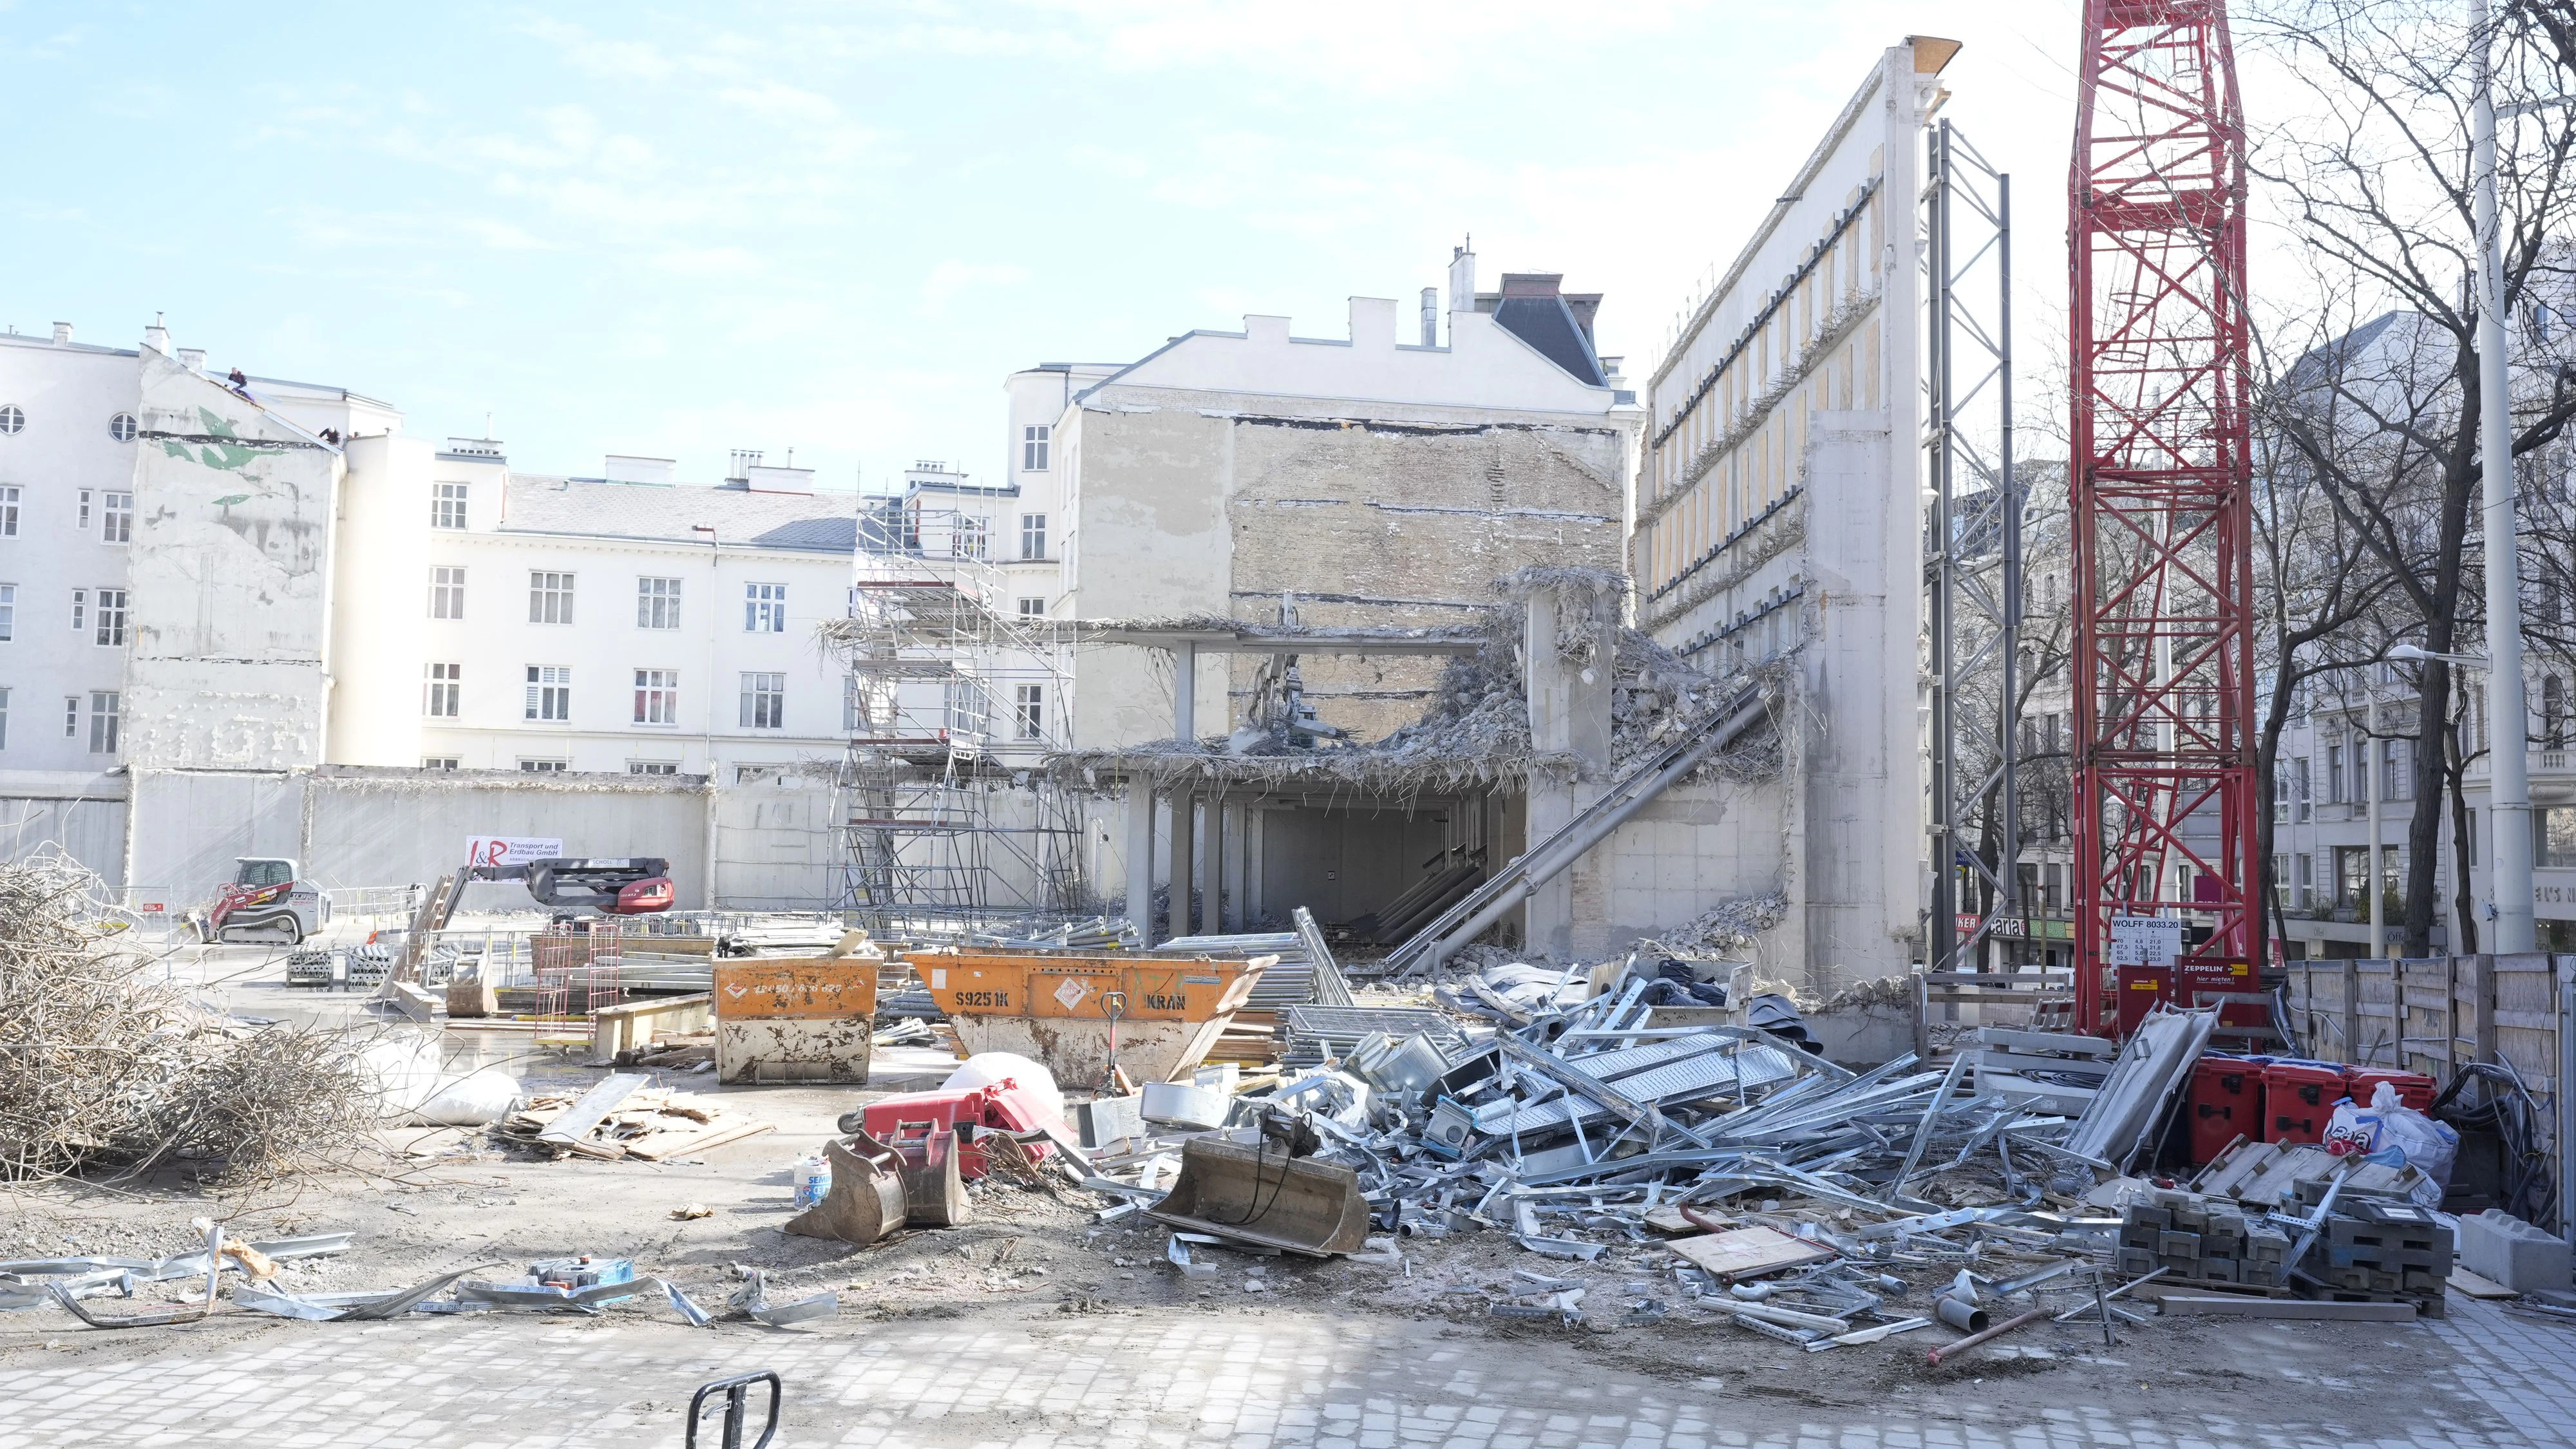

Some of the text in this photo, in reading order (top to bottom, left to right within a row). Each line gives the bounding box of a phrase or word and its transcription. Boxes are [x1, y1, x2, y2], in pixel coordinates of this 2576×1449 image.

[1956, 918, 1976, 929] KER
[1991, 918, 2020, 936] carla
[2031, 921, 2065, 937] PO-UP
[1147, 994, 1186, 1010] KRAN
